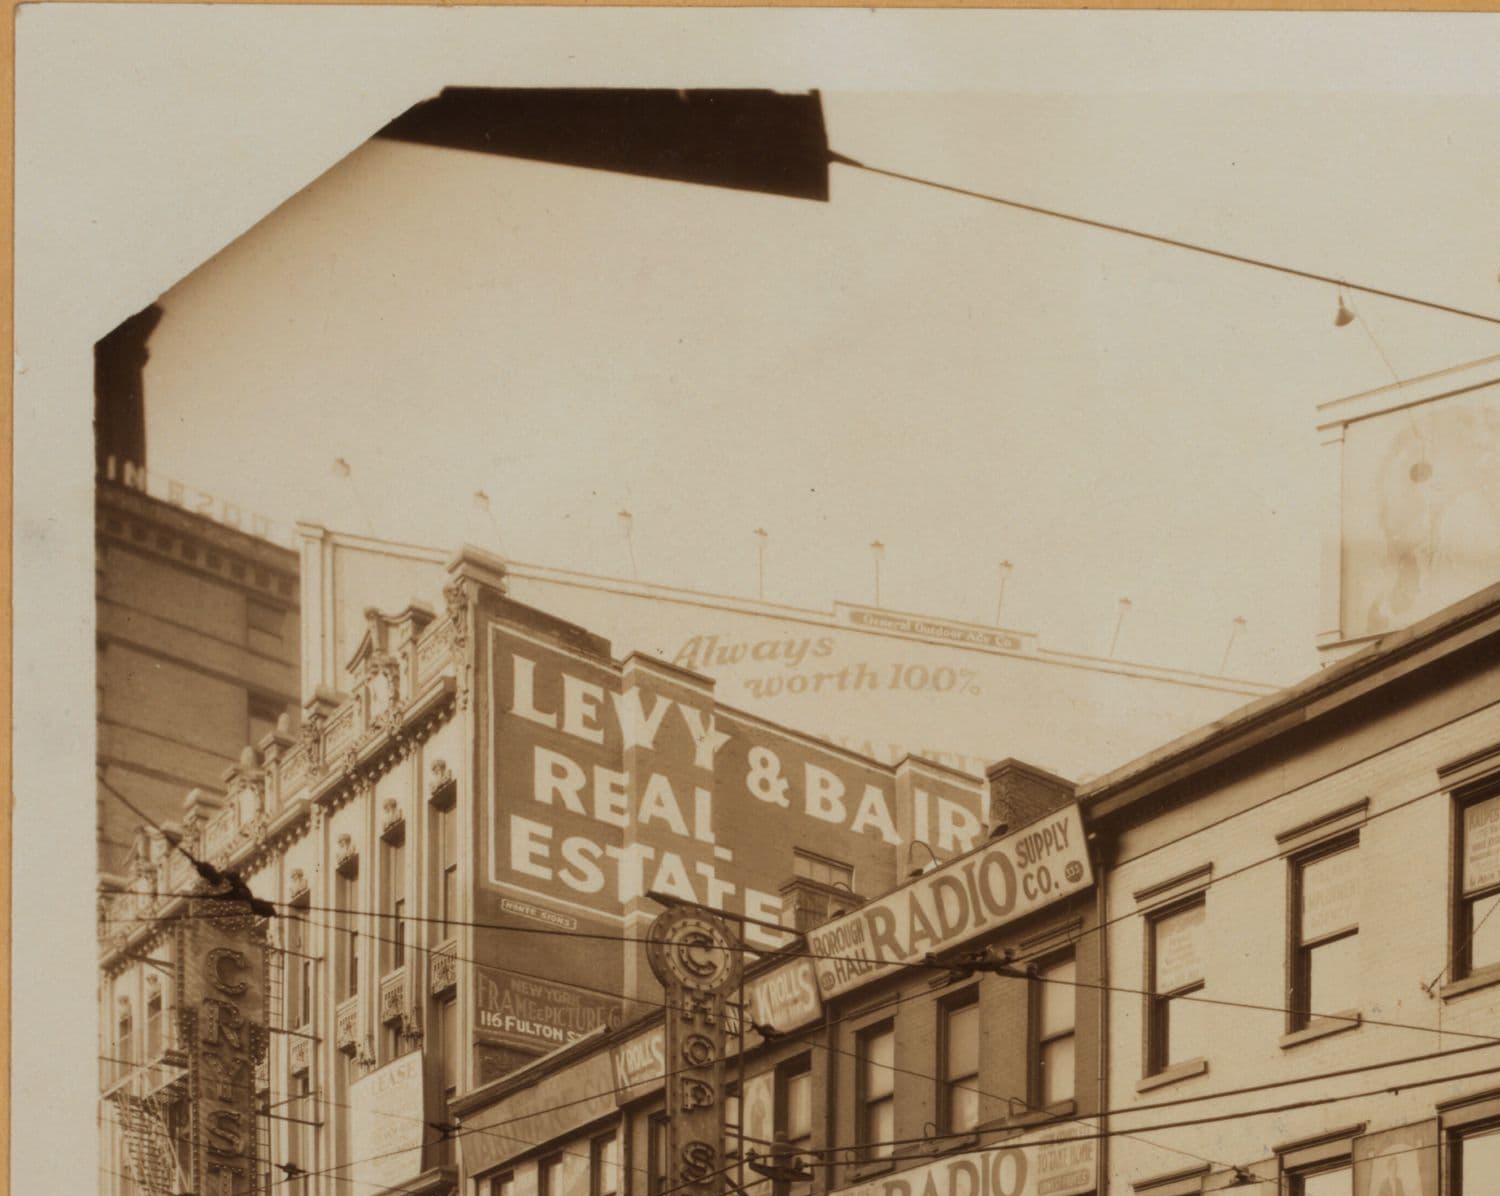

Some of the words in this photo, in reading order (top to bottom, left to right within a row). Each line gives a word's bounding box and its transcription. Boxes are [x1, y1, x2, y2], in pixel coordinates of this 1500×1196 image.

[673, 634, 836, 672] Always
[743, 661, 881, 700] worth
[889, 662, 983, 696] 100%
[510, 652, 731, 772] LEVY
[746, 744, 791, 809] &
[533, 744, 717, 846] REAL
[1014, 817, 1070, 869] SUPPLY
[1021, 867, 1060, 901] CO.
[864, 850, 1018, 970] RADIO
[812, 918, 865, 959] BOROUGH
[834, 947, 873, 988] HALL
[480, 1009, 503, 1029] 116
[504, 1014, 564, 1043] FULTON
